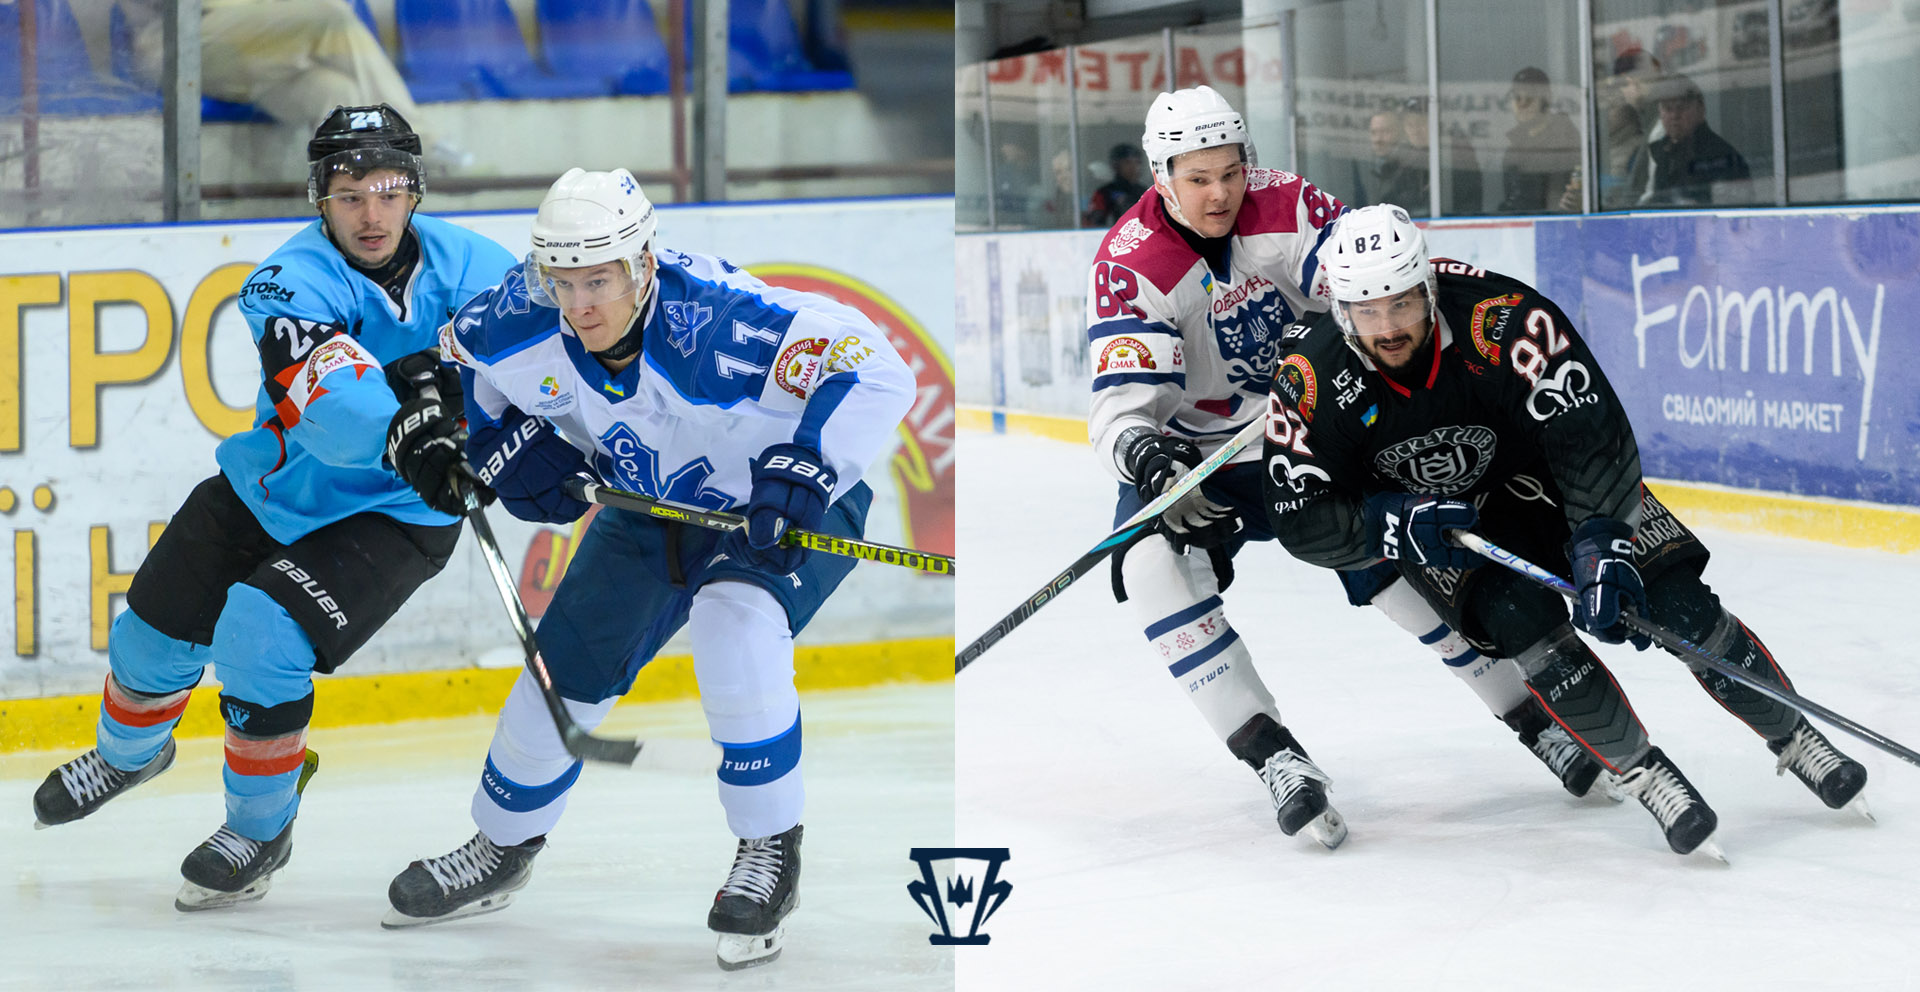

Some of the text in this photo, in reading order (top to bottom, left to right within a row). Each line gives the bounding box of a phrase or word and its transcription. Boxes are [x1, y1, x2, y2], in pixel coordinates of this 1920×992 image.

[350, 111, 382, 129] 24
[1194, 120, 1225, 131] BAUER
[1354, 233, 1381, 254] 82
[238, 281, 296, 303] STORM
[1095, 261, 1147, 320] 82
[1492, 306, 1513, 341] СМАК
[1511, 308, 1570, 390] 82
[1630, 253, 1885, 460] Fammy
[320, 355, 347, 375] СМАК
[799, 359, 819, 389] СМАК
[1110, 360, 1136, 369] СМАК
[1278, 374, 1299, 403] СМАК
[1332, 368, 1353, 391] ICE
[1335, 376, 1367, 410] PEAK
[1265, 388, 1315, 458] 82
[1662, 389, 1844, 433] СВІДОМИЙ МАРКЕТ
[1453, 428, 1493, 448] CLUB
[788, 529, 949, 575] HERWOOD
[271, 558, 349, 631] BAUER
[1199, 662, 1230, 686] TWOL
[1561, 662, 1595, 691] TWOL
[724, 757, 772, 772] TWOL
